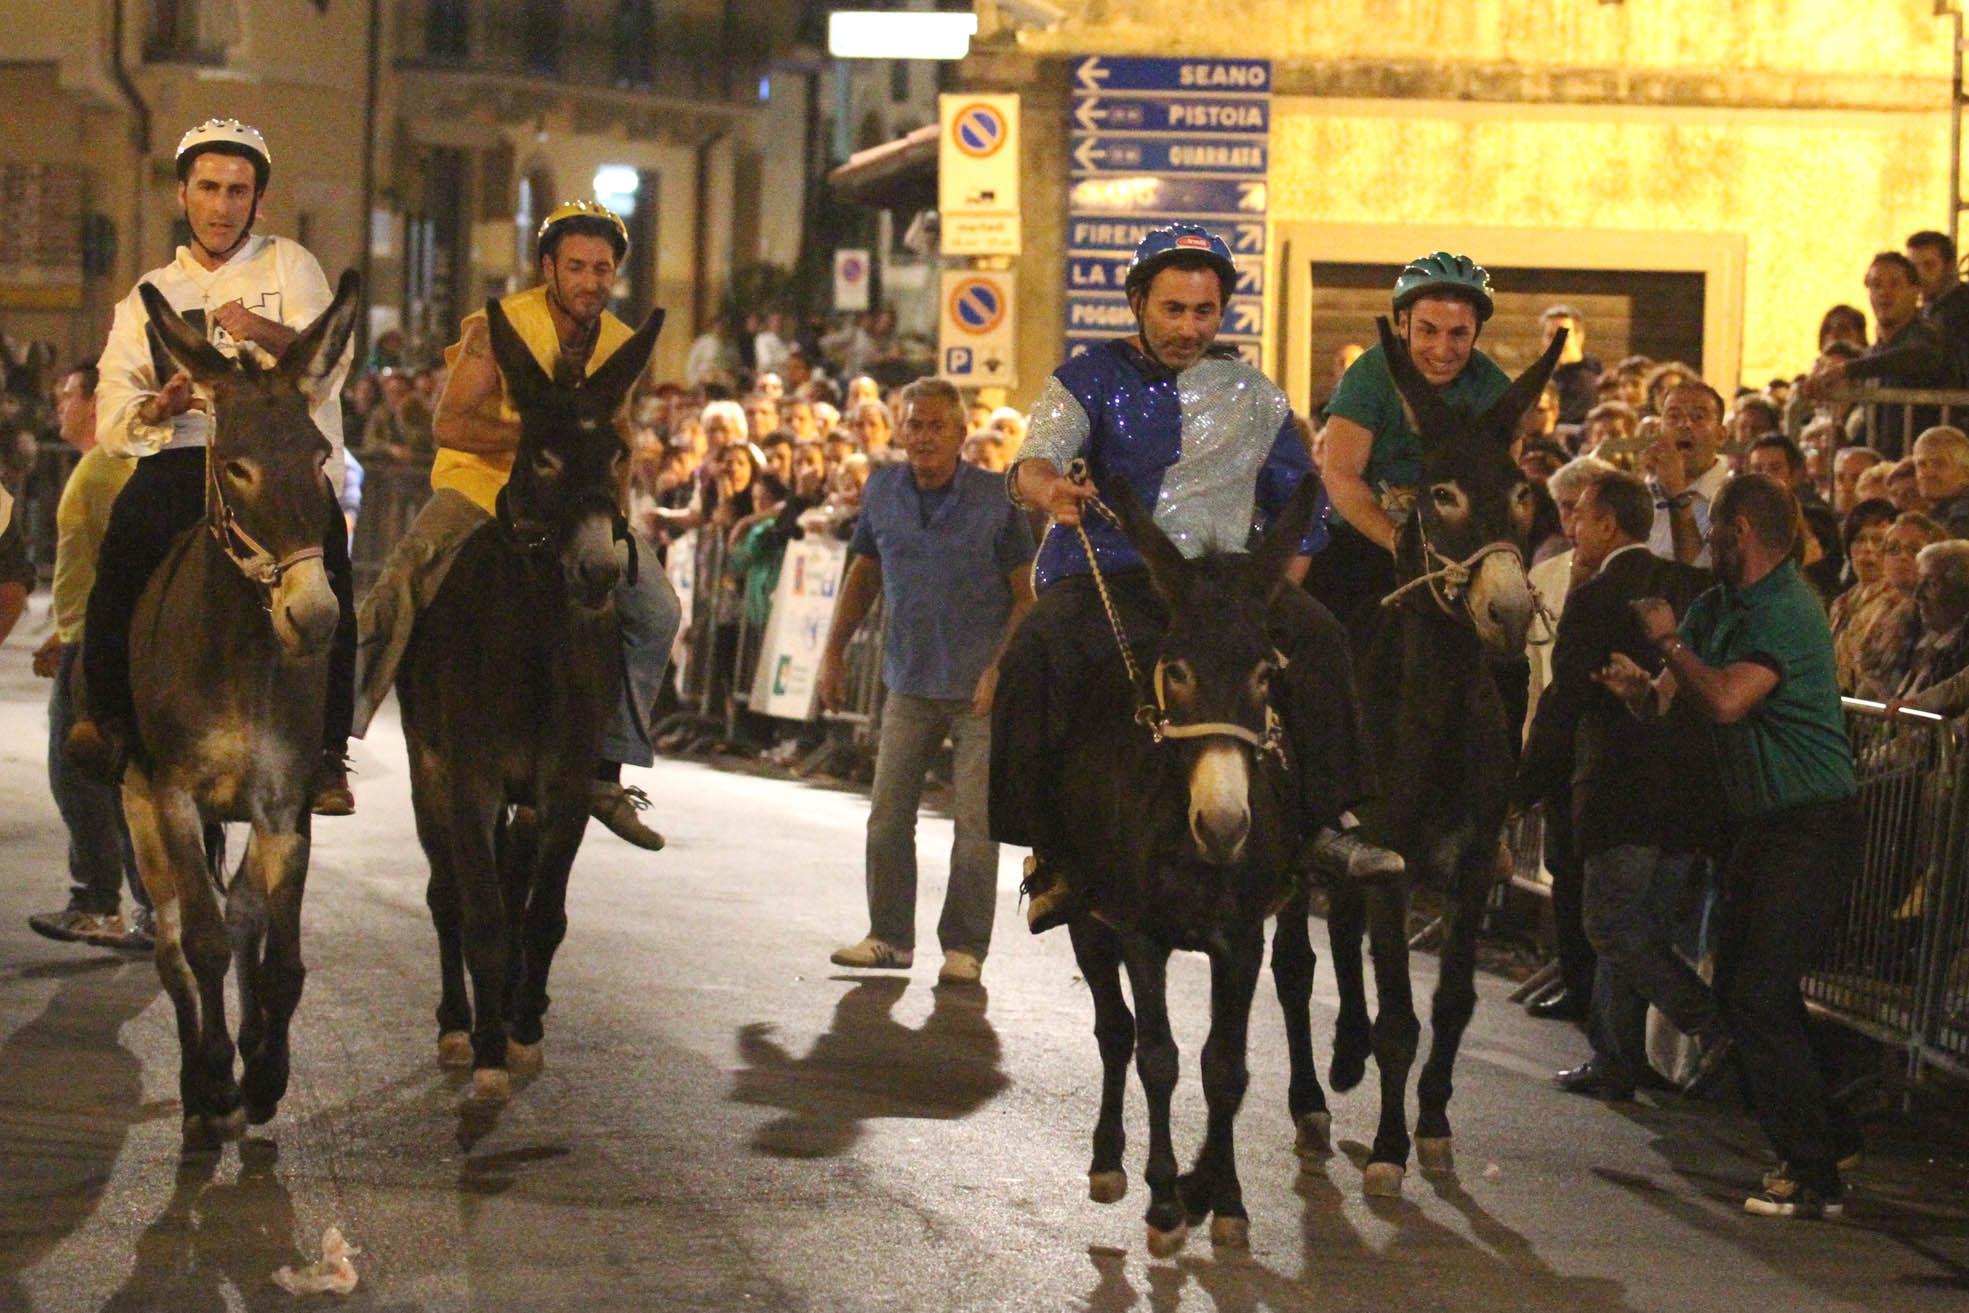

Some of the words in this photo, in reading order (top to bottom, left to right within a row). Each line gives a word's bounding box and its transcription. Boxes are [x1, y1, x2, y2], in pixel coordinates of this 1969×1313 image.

[1179, 65, 1266, 86] SEANO
[1168, 104, 1263, 126] PISTOIA
[1074, 223, 1157, 244] FIREN
[1072, 264, 1107, 284] LA
